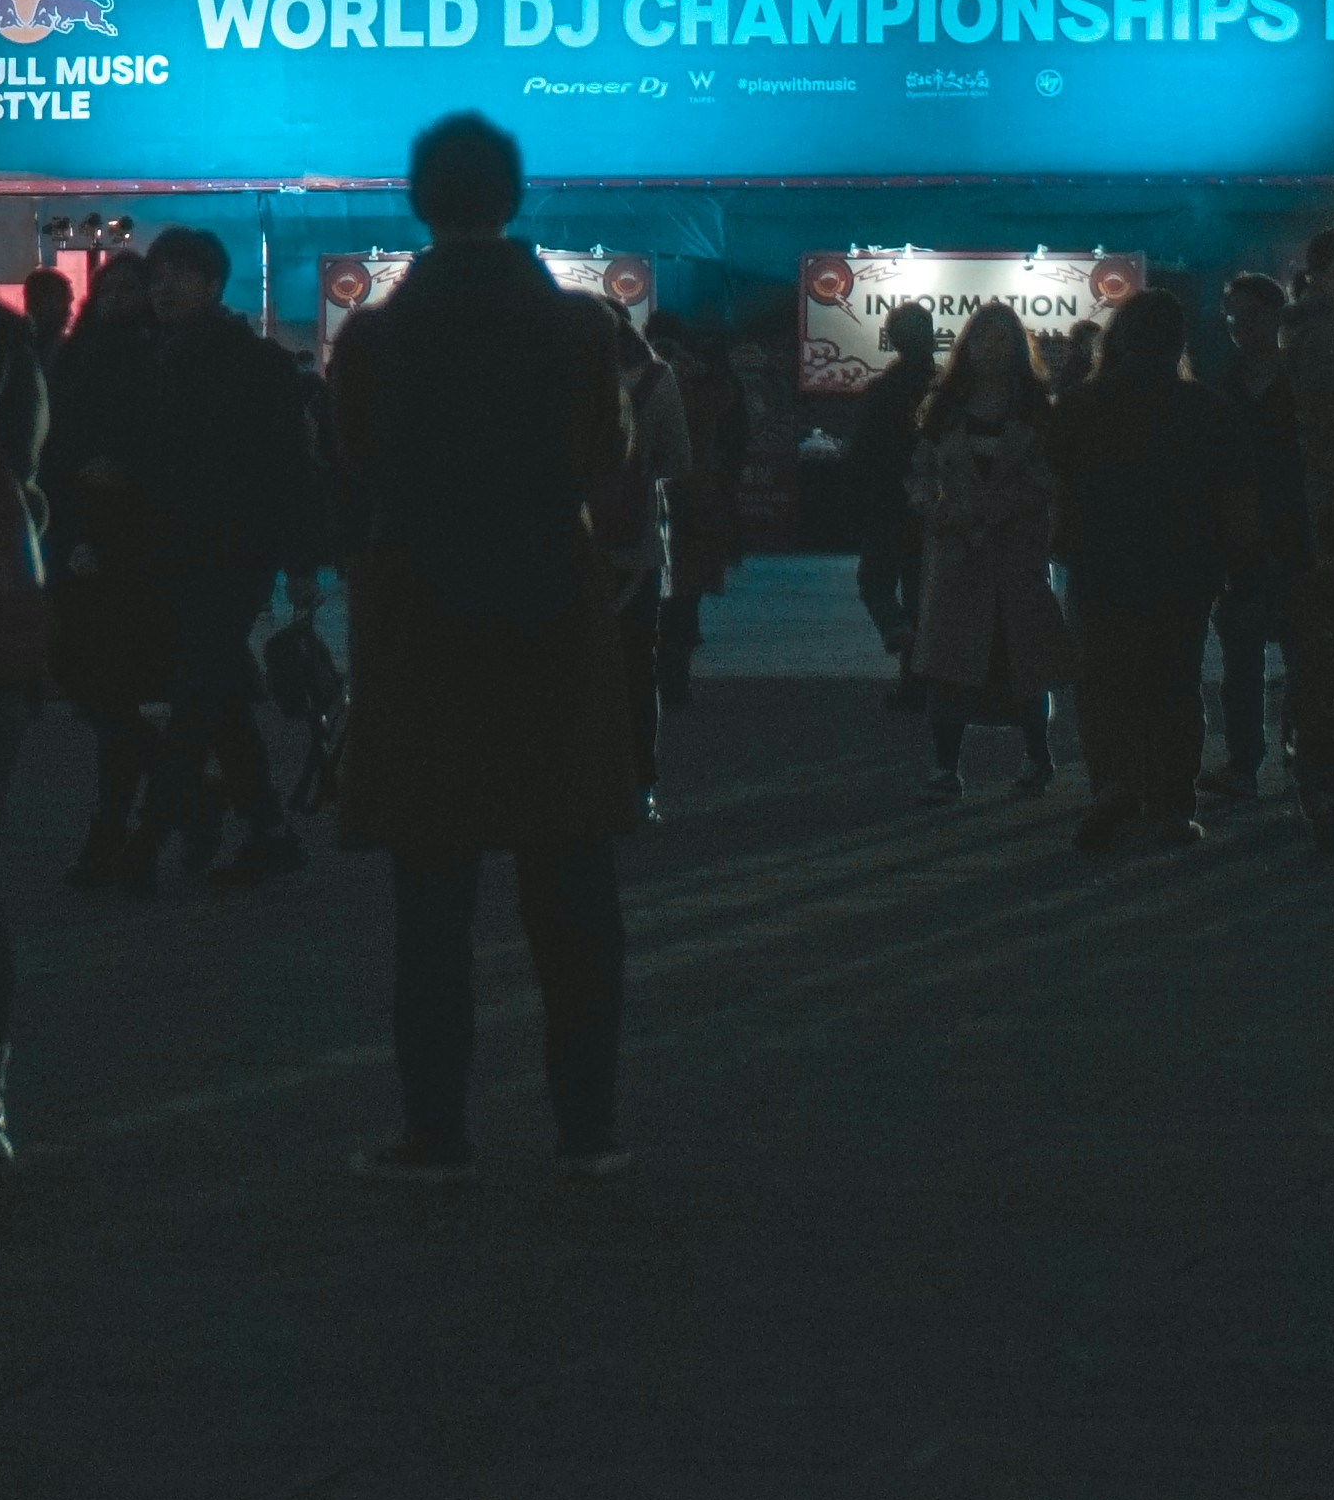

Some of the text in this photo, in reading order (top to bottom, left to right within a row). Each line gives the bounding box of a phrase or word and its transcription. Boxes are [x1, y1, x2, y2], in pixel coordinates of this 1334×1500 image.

[55, 54, 169, 86] MUSIC
[687, 69, 716, 90] W
[522, 75, 633, 95] Pioneer
[737, 77, 857, 95] #playwithmusic
[866, 293, 1077, 317] INORMTION
